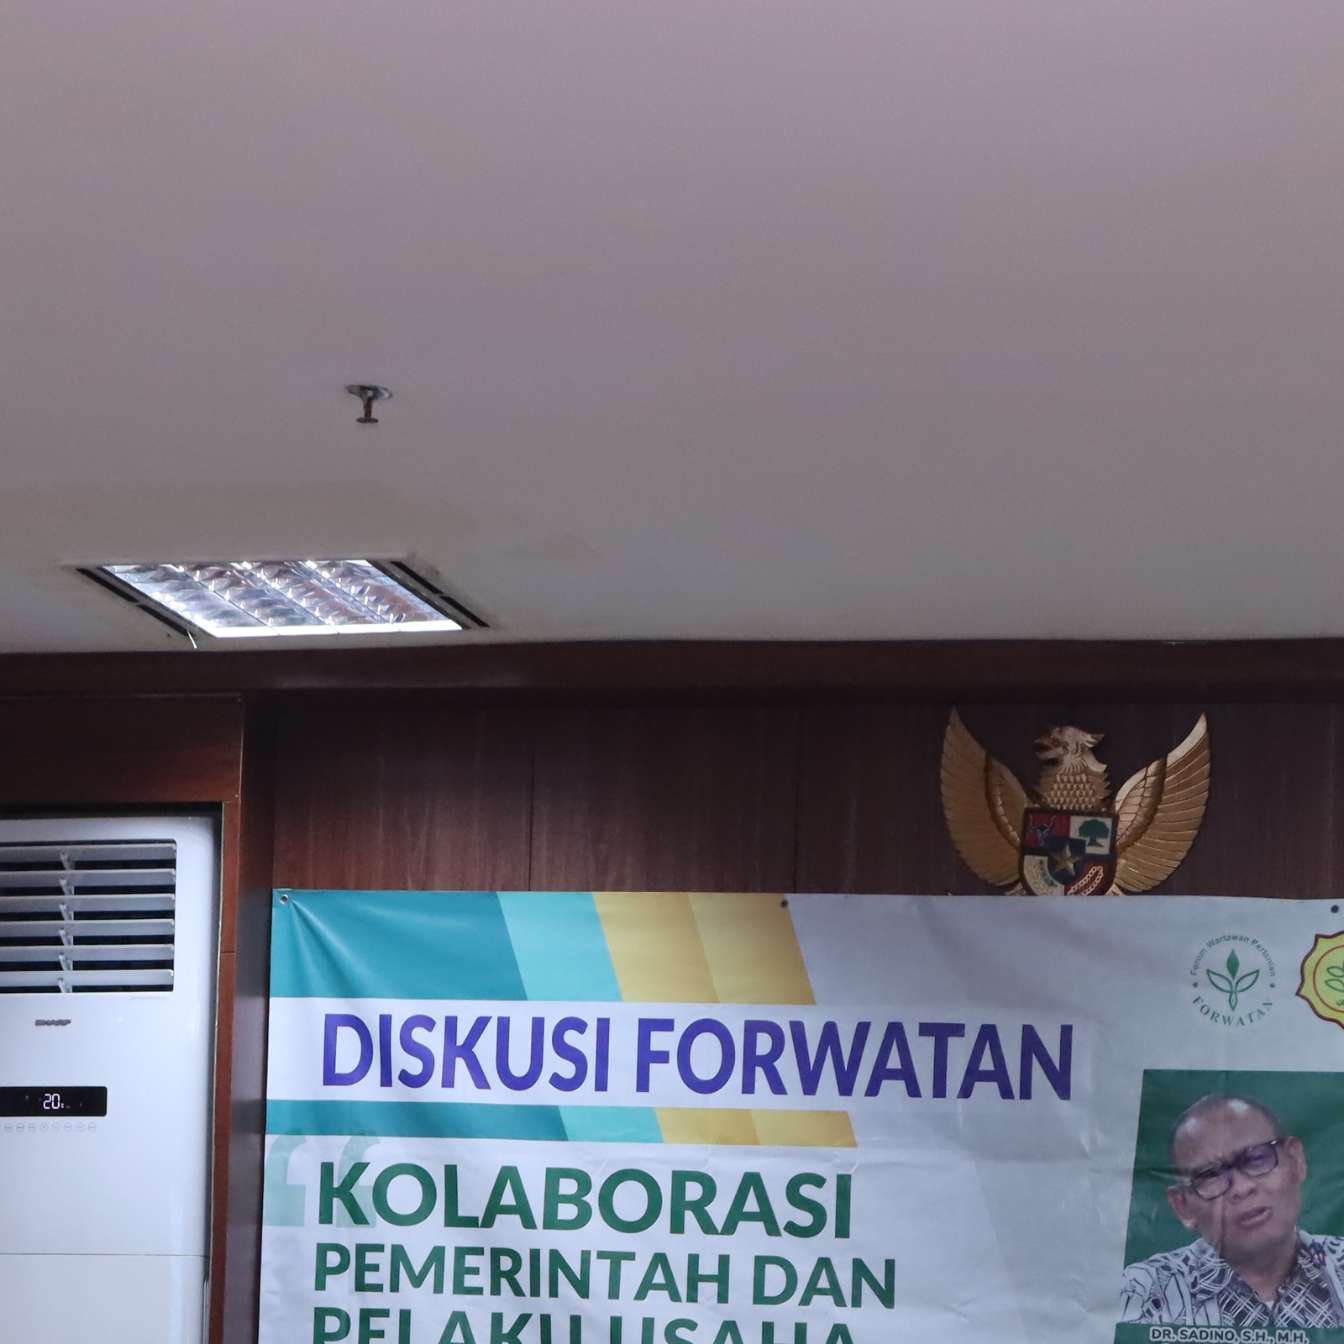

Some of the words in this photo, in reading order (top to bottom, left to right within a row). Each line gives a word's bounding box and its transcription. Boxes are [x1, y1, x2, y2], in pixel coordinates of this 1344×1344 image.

[323, 1012, 609, 1092] DISKUSI
[636, 1017, 1074, 1101] FORWATAN
[318, 1160, 853, 1239] KOLABORASI
[313, 1242, 732, 1305] PEMERINTAH
[752, 1254, 897, 1309] DAN
[1150, 1327, 1175, 1342] DR.
